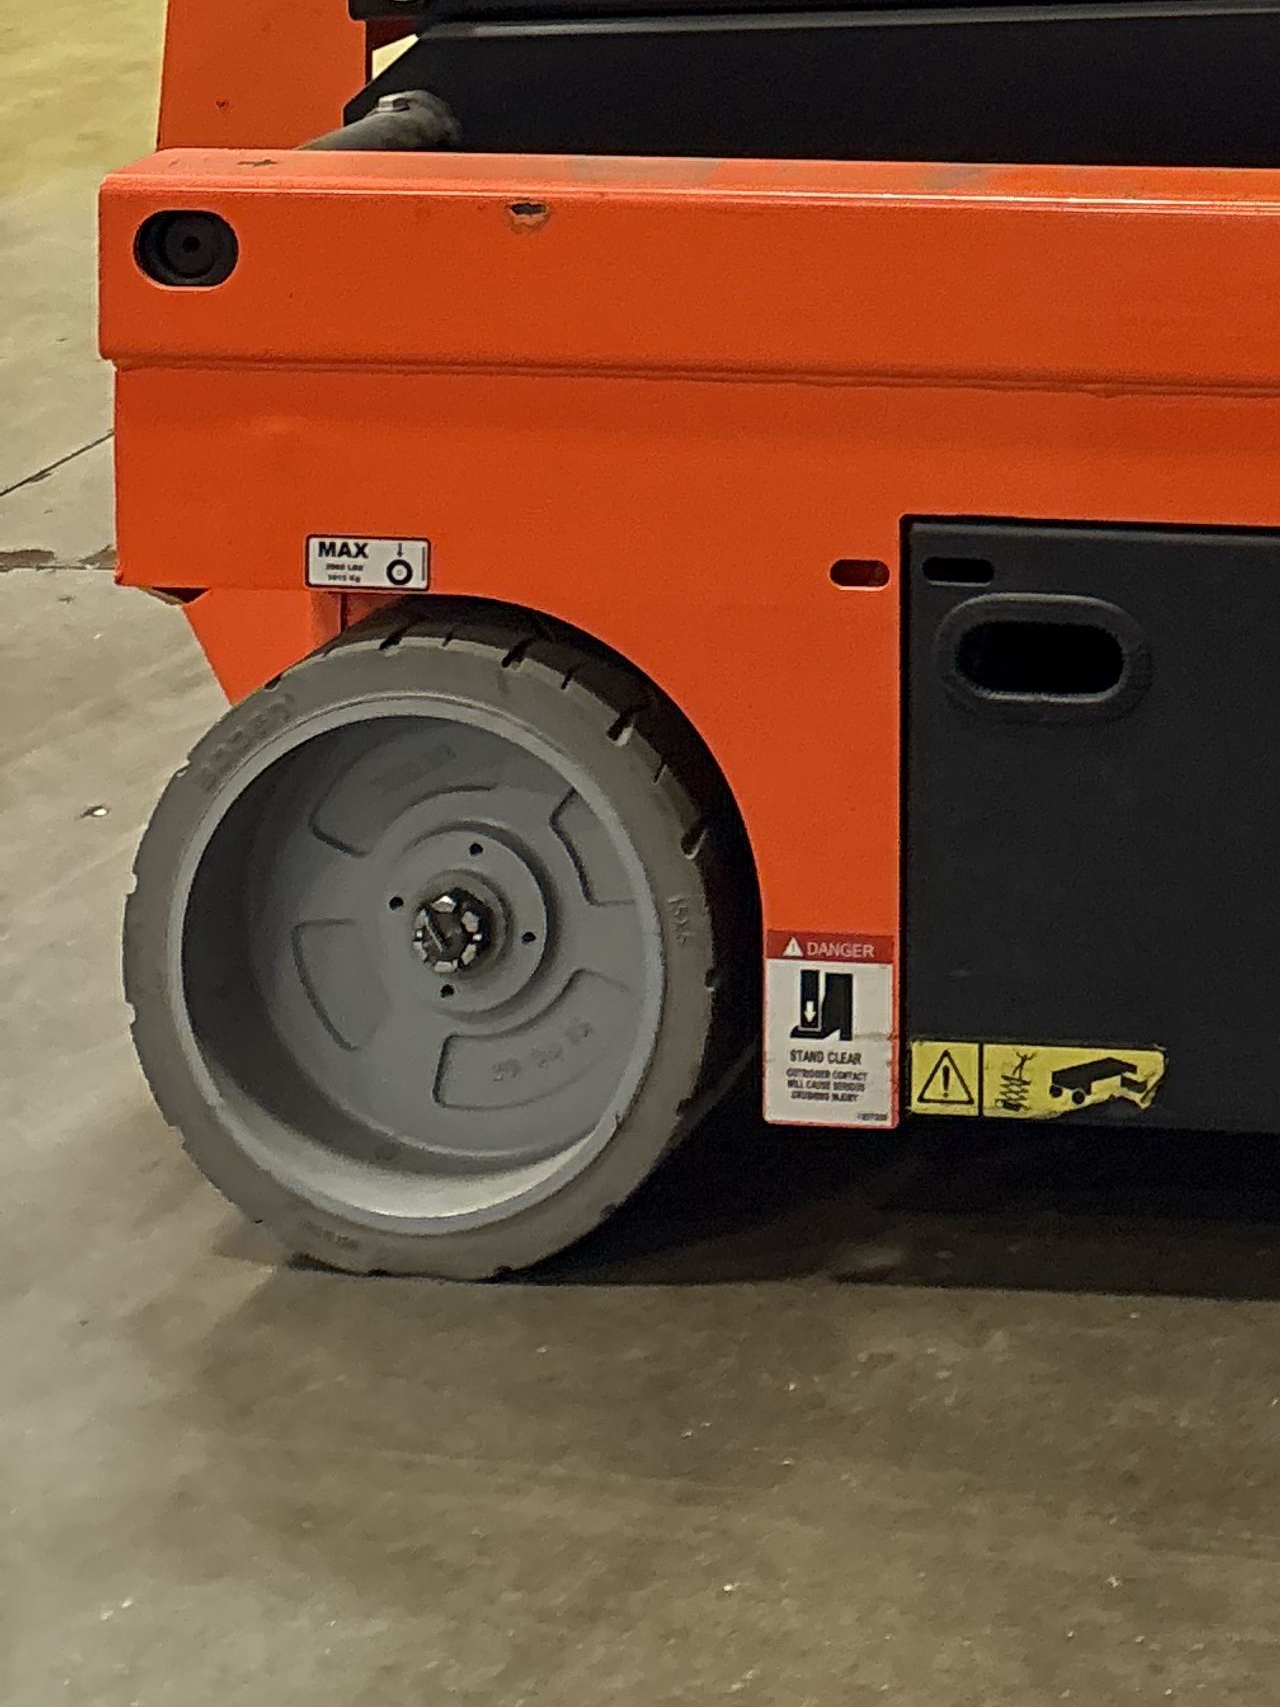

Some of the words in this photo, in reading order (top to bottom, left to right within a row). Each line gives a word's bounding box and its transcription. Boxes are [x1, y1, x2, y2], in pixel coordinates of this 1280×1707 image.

[318, 542, 369, 559] MAX
[807, 942, 874, 958] DANGER
[789, 1049, 824, 1063] STAND
[827, 1051, 862, 1065] CLEAR
